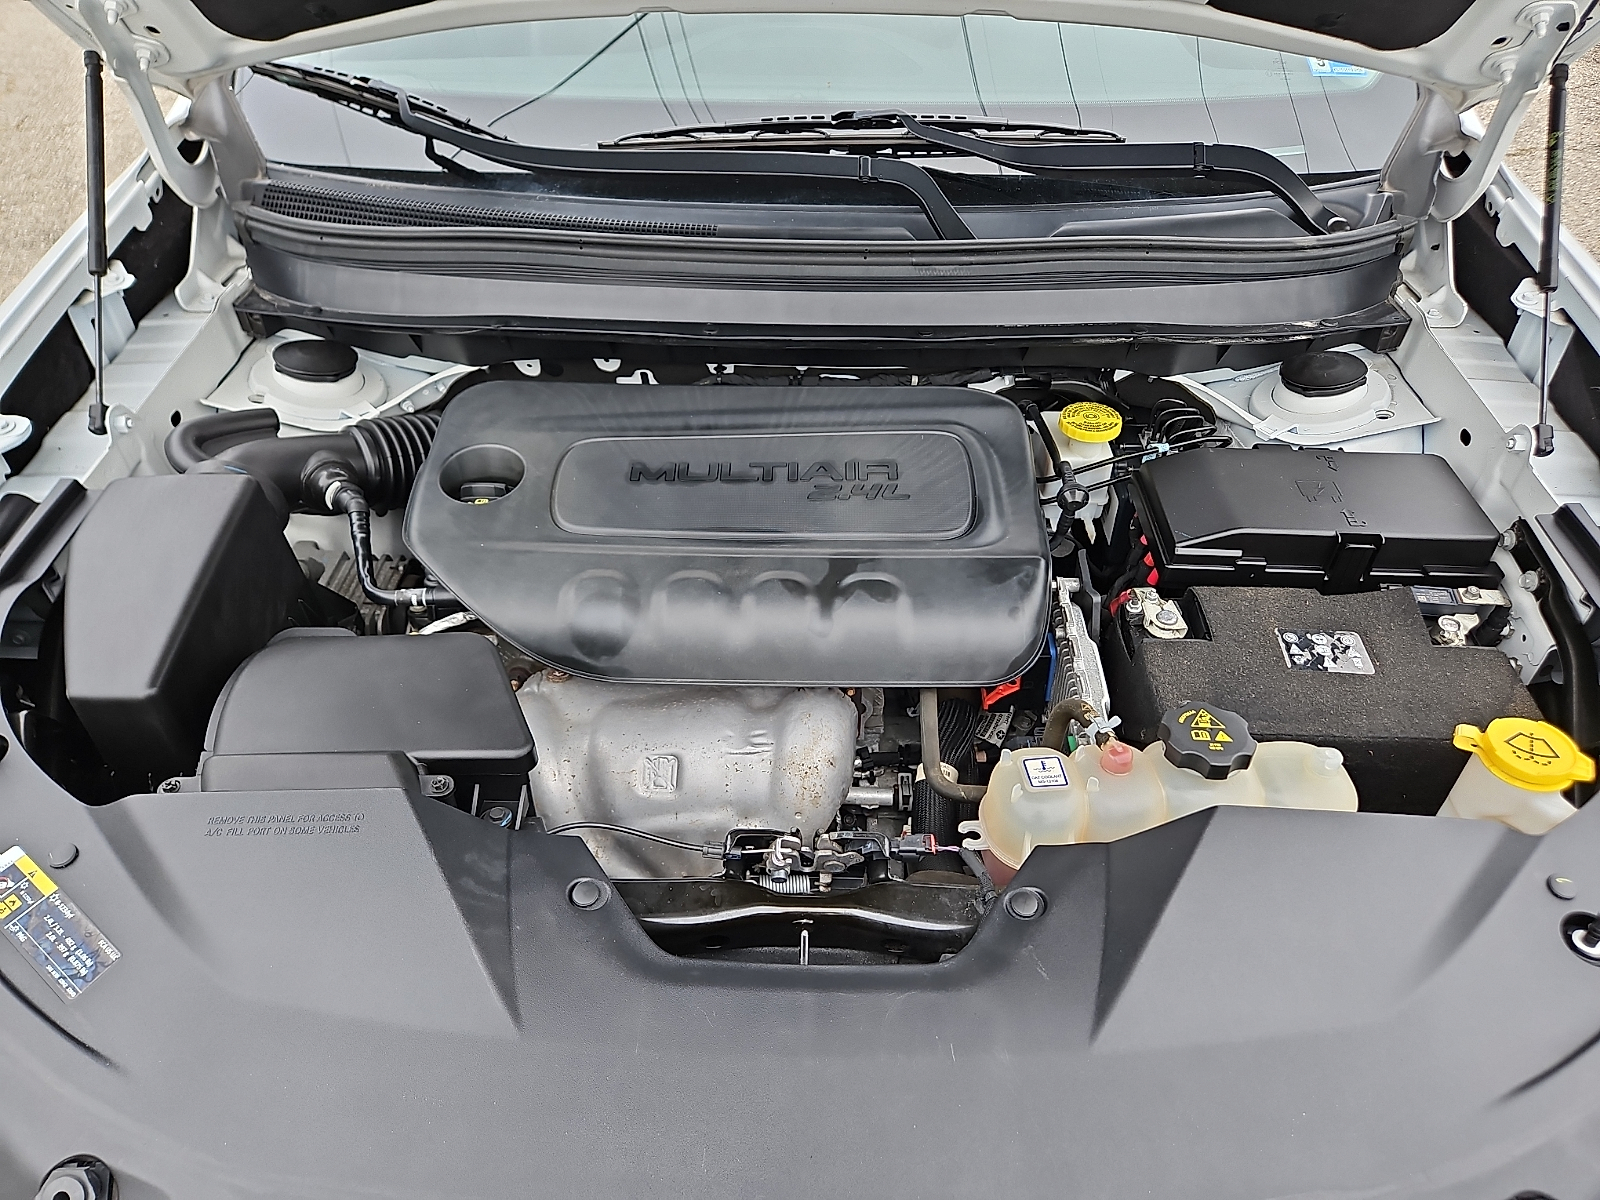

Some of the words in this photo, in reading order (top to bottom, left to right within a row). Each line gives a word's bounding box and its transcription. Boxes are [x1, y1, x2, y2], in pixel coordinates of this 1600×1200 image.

[629, 461, 899, 482] MULTIAIR
[806, 483, 911, 501] 2.4L
[208, 816, 245, 825] REMOVE
[247, 815, 267, 824] THIS
[267, 814, 295, 823] PANEL
[297, 813, 316, 823] FOR
[317, 813, 351, 822] ACCESS
[204, 827, 223, 837] A/C
[226, 827, 244, 836] FILL
[247, 826, 271, 836] PORT
[273, 826, 287, 835] ON
[289, 825, 315, 835] SOME
[317, 824, 360, 834] VEHICLES
